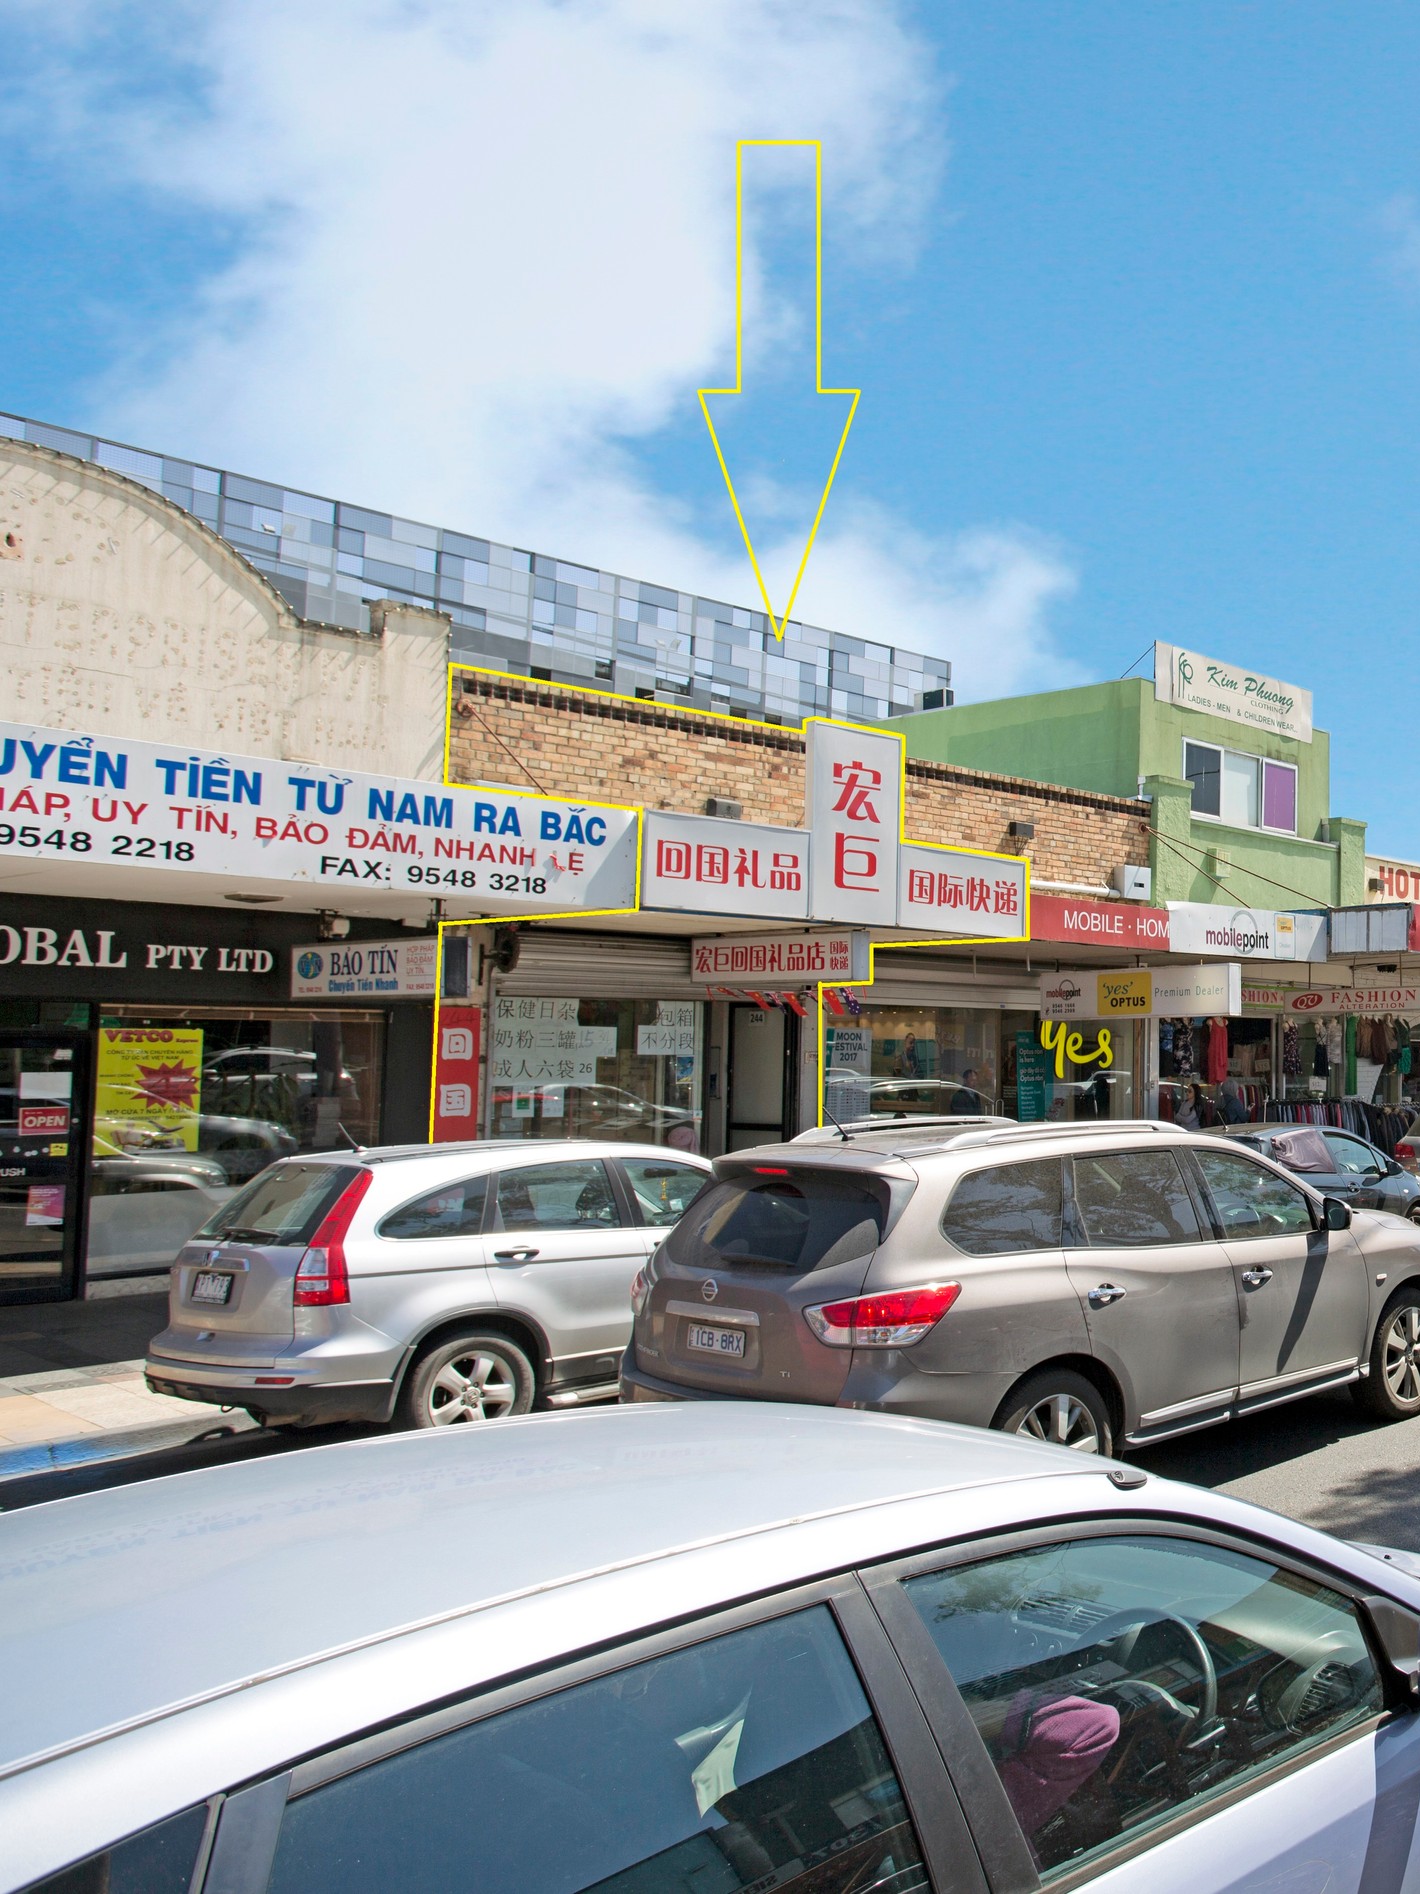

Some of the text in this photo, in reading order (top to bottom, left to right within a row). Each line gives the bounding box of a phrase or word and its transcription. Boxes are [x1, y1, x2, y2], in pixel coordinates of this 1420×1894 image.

[1206, 666, 1294, 714] Kim Phuong
[1187, 693, 1211, 708] LADIES
[1216, 702, 1231, 713] MEN
[1236, 708, 1242, 717] &
[1244, 711, 1275, 726] CHILDREN
[1250, 700, 1284, 715] CLOTHING
[368, 788, 453, 829] NAM
[474, 802, 522, 837] RA
[540, 806, 607, 847] BẮC
[832, 760, 882, 893] 宏巨
[0, 823, 195, 862] 9548 2218
[91, 798, 149, 825] UY
[255, 813, 329, 845] BẢO
[434, 837, 536, 867] NHANH
[320, 855, 547, 895] FAX: 9548 3218
[656, 838, 801, 892] 回国礼品
[909, 869, 1018, 917] 国际快递
[1063, 909, 1123, 935] MOBILE
[1205, 927, 1269, 952] mobilepoint
[145, 944, 208, 970] PTY
[217, 948, 273, 973] LTD
[330, 946, 362, 975] BẢO
[695, 942, 826, 974] 宏巨回国礼品店
[375, 977, 398, 990] Nhanh
[1046, 986, 1081, 1000] mobilepoint
[1154, 985, 1225, 998] Premium Dealer
[496, 998, 577, 1019] 保健日杂
[1110, 996, 1146, 1008] OPTUS
[1331, 990, 1416, 1003] FASHION
[750, 1013, 763, 1023] 244
[105, 1029, 174, 1043] VETCO
[641, 1031, 694, 1050] 不分段
[836, 1032, 862, 1041] MOON
[840, 1052, 857, 1061] 2017
[1040, 1019, 1114, 1079] yes
[24, 1115, 66, 1128] OPEN
[0, 1167, 26, 1177] USH
